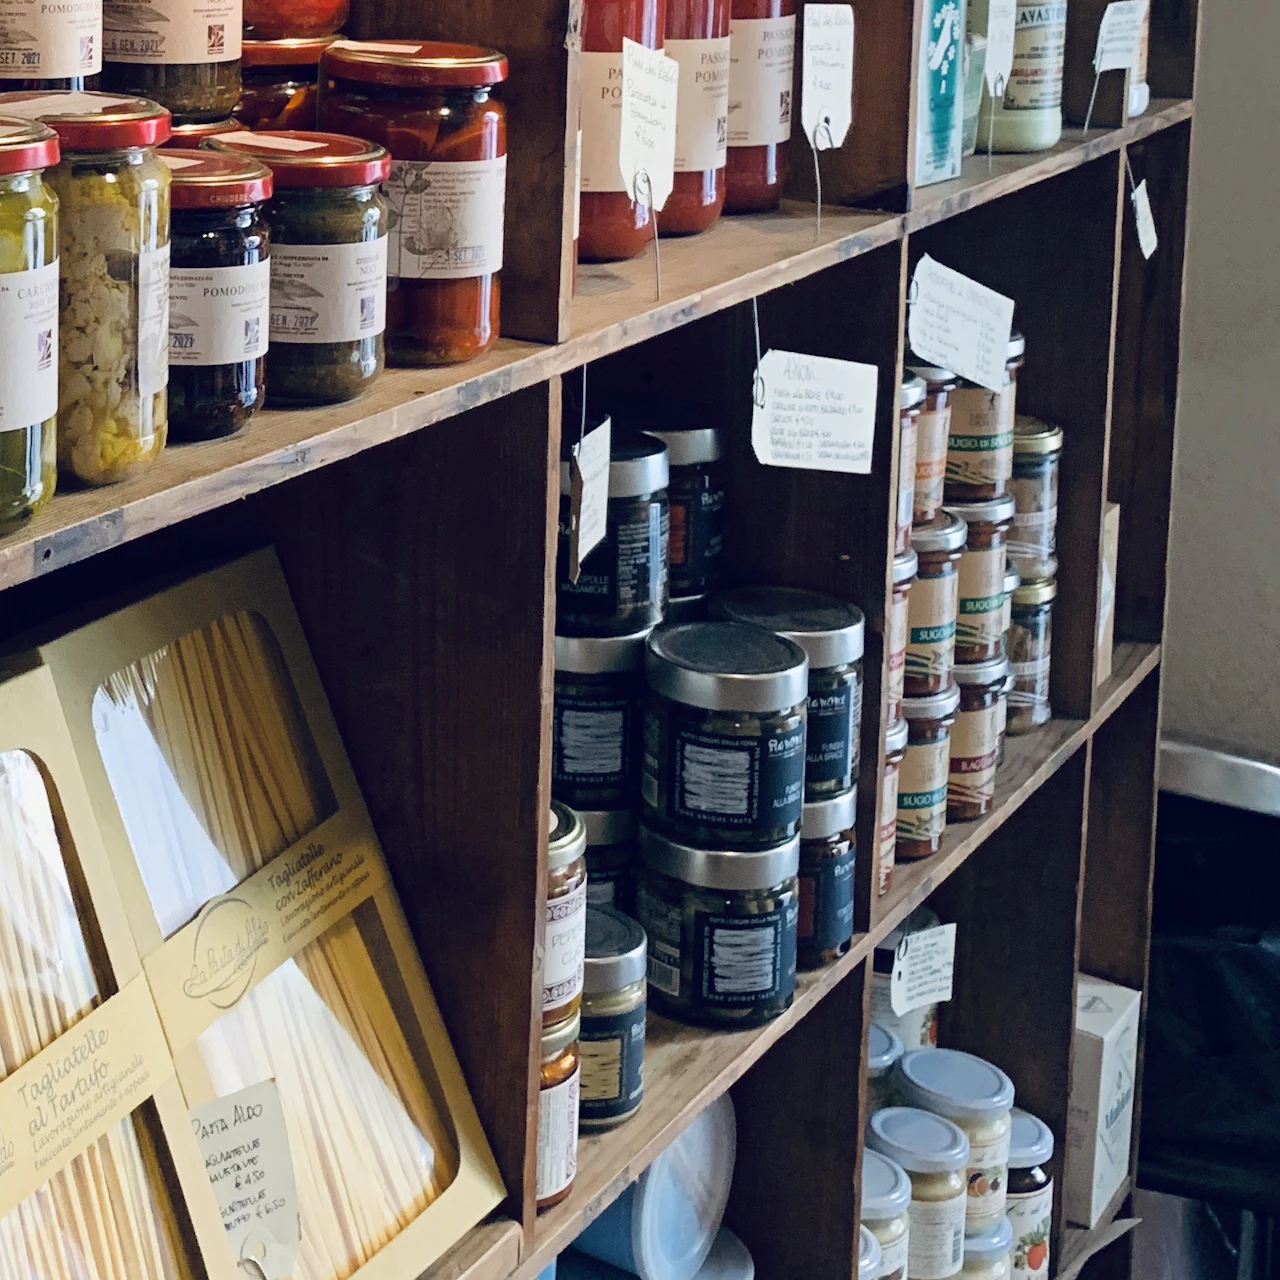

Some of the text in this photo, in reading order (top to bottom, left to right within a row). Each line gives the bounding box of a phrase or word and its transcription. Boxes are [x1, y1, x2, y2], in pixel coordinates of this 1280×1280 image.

[139, 39, 160, 53] 2021
[21, 52, 41, 65] 2021
[454, 248, 468, 261] SET
[902, 794, 932, 807] SUGO
[267, 842, 325, 892] Tagliatelle
[275, 891, 297, 912] con
[244, 916, 270, 948] Aldo
[16, 1027, 111, 1108] Tagliatelle
[28, 1057, 111, 1137] al Tartufo
[32, 1053, 147, 1154] Lavorazione artigianale
[234, 1174, 243, 1191] €
